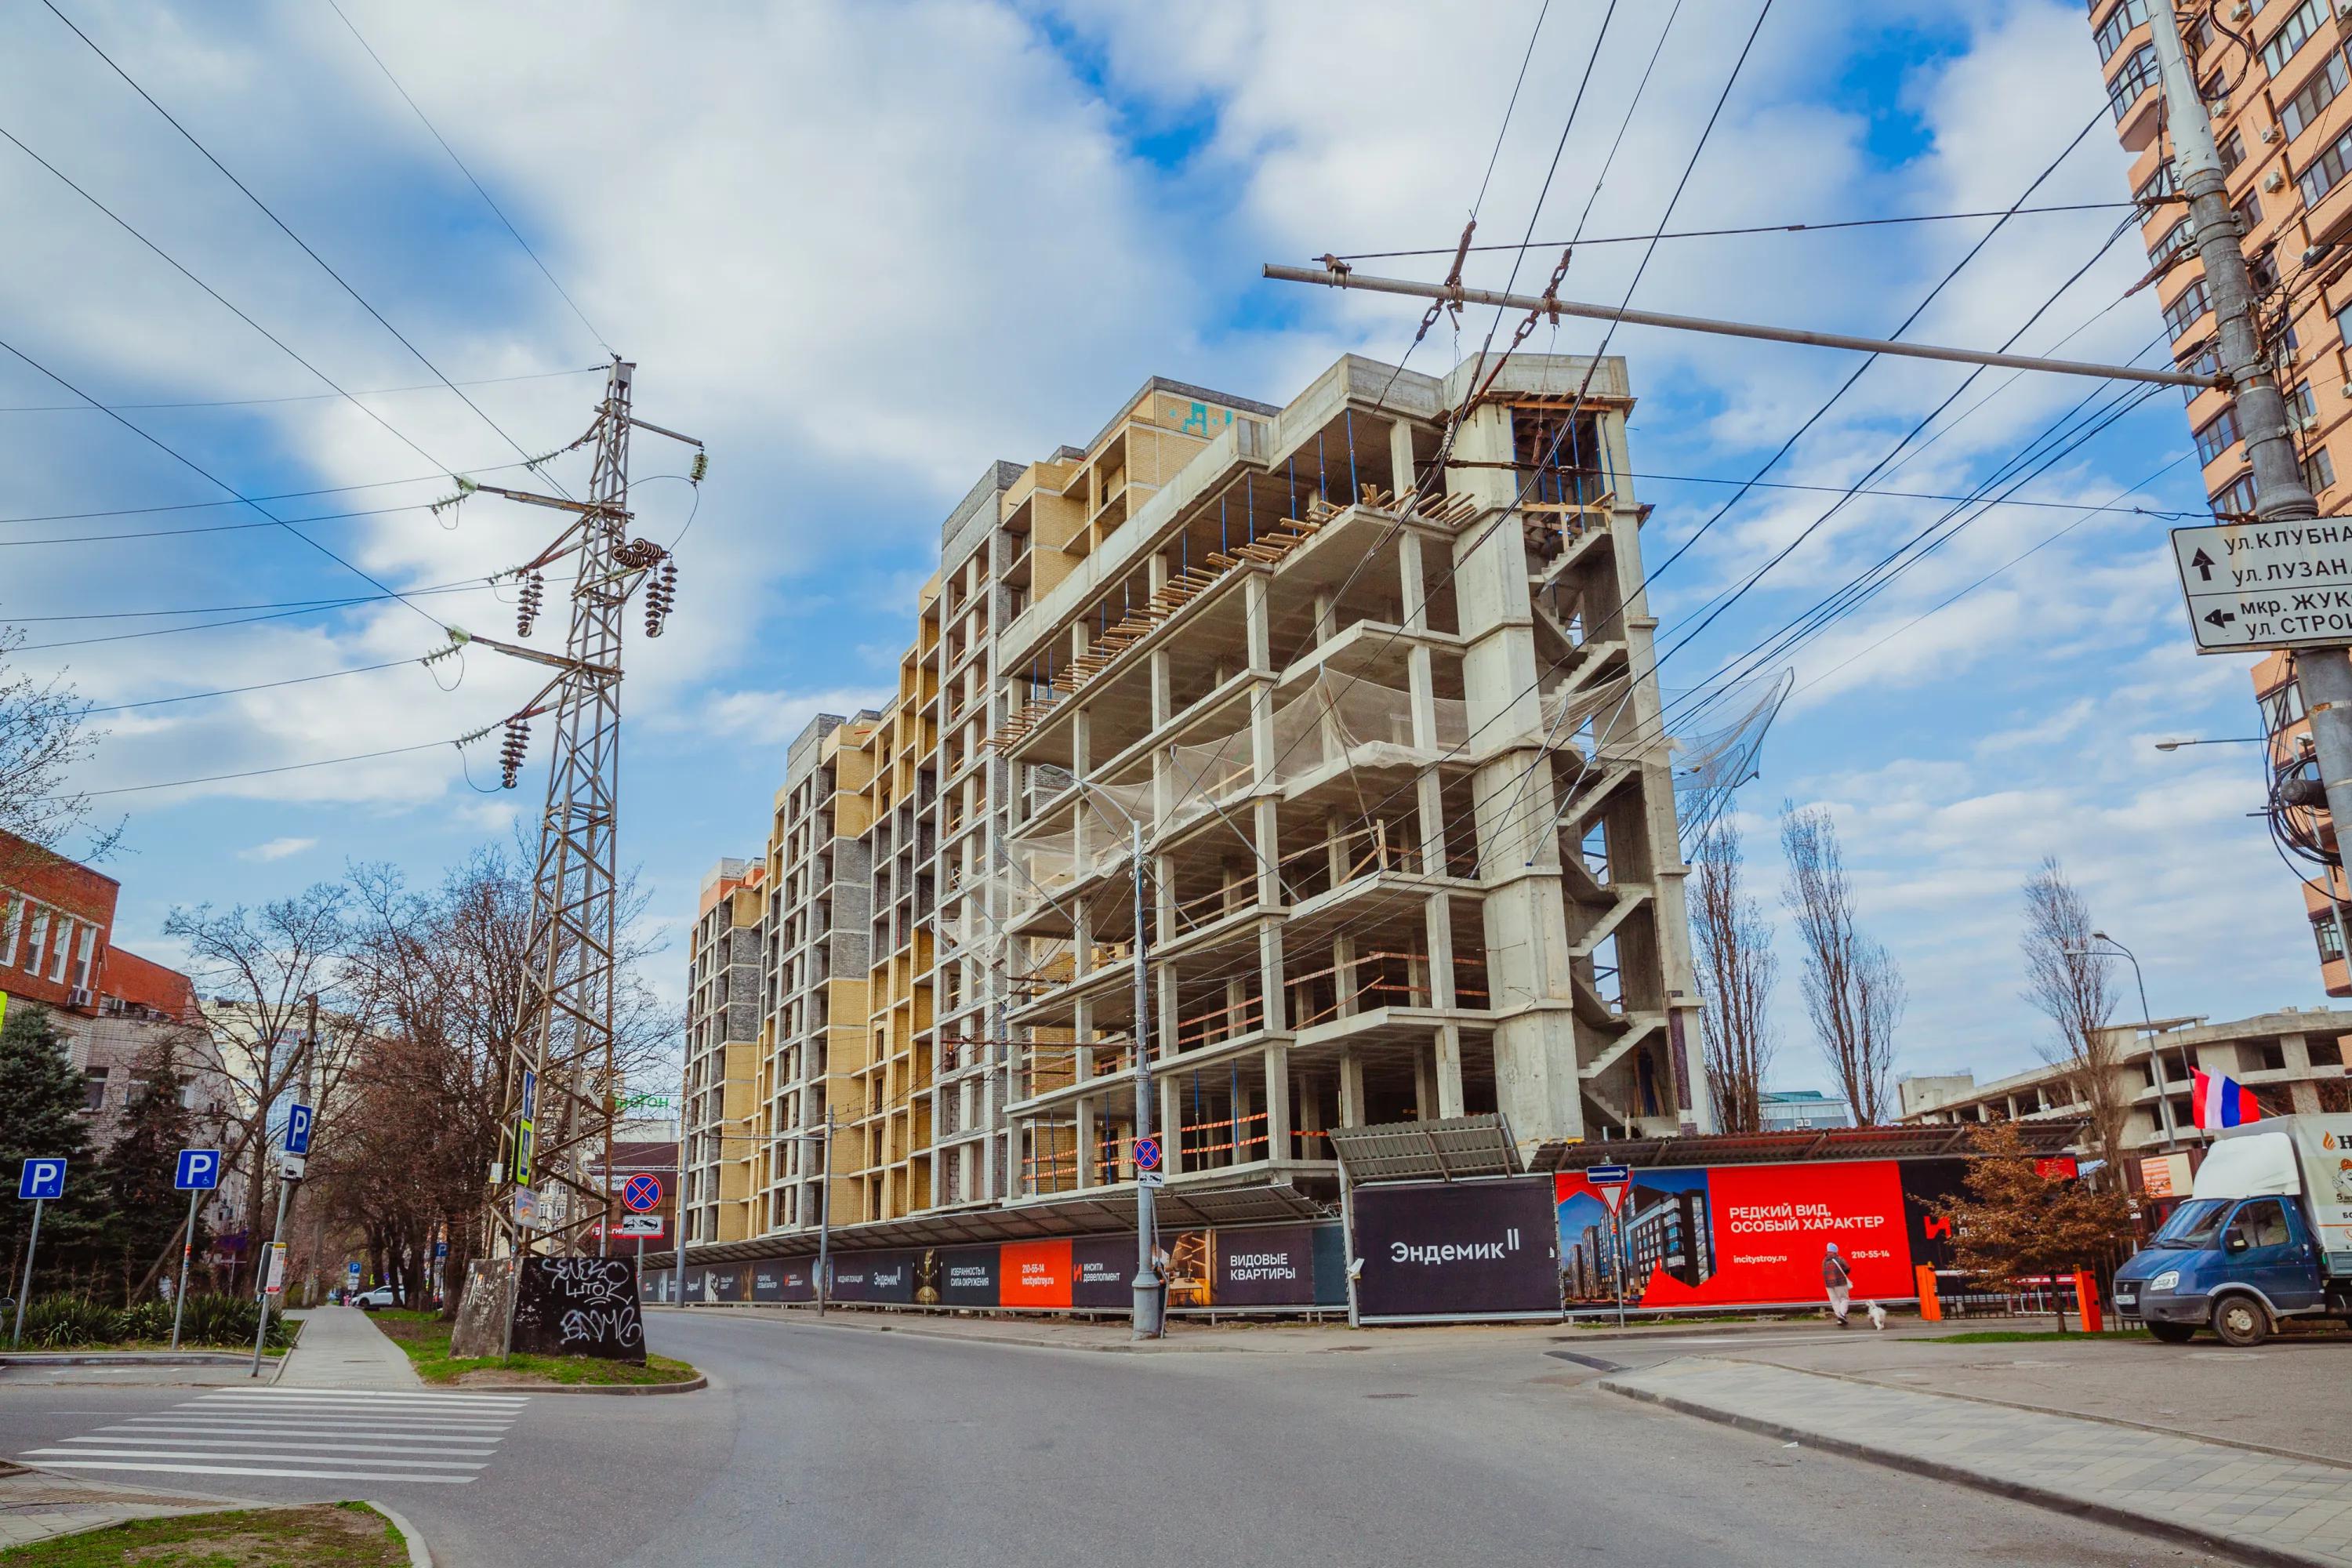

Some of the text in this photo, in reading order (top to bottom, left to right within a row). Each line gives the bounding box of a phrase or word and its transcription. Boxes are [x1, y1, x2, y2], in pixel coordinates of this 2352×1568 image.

[2224, 537, 2254, 556] ул.
[2232, 558, 2352, 587] ул. ЛУЗАН
[2240, 591, 2352, 617] мкр. ЖУК
[2245, 623, 2275, 641] ул.
[187, 1155, 211, 1184] P
[31, 1164, 57, 1193] P
[1730, 1203, 1831, 1220] РЕДКИЙ ВИД,
[1730, 1216, 1885, 1233] ОСОБЫЙ ХАРАКТЕР
[1230, 1254, 1288, 1268] ВИДОВЫЕ
[1390, 1242, 1505, 1265] Эндемик
[1733, 1255, 1788, 1265] incitystroy.ru
[1851, 1250, 1890, 1259] 210-55-14
[951, 1267, 981, 1276] ИЗБРАННОСТЬ
[1022, 1264, 1044, 1273] 210-55-14
[1230, 1268, 1296, 1280] КВАРТИРЫ
[874, 1272, 898, 1287] Эндемик
[963, 1277, 989, 1286] ОКРУЖЕНИЯ
[1022, 1276, 1054, 1287] incitystroy.ru
